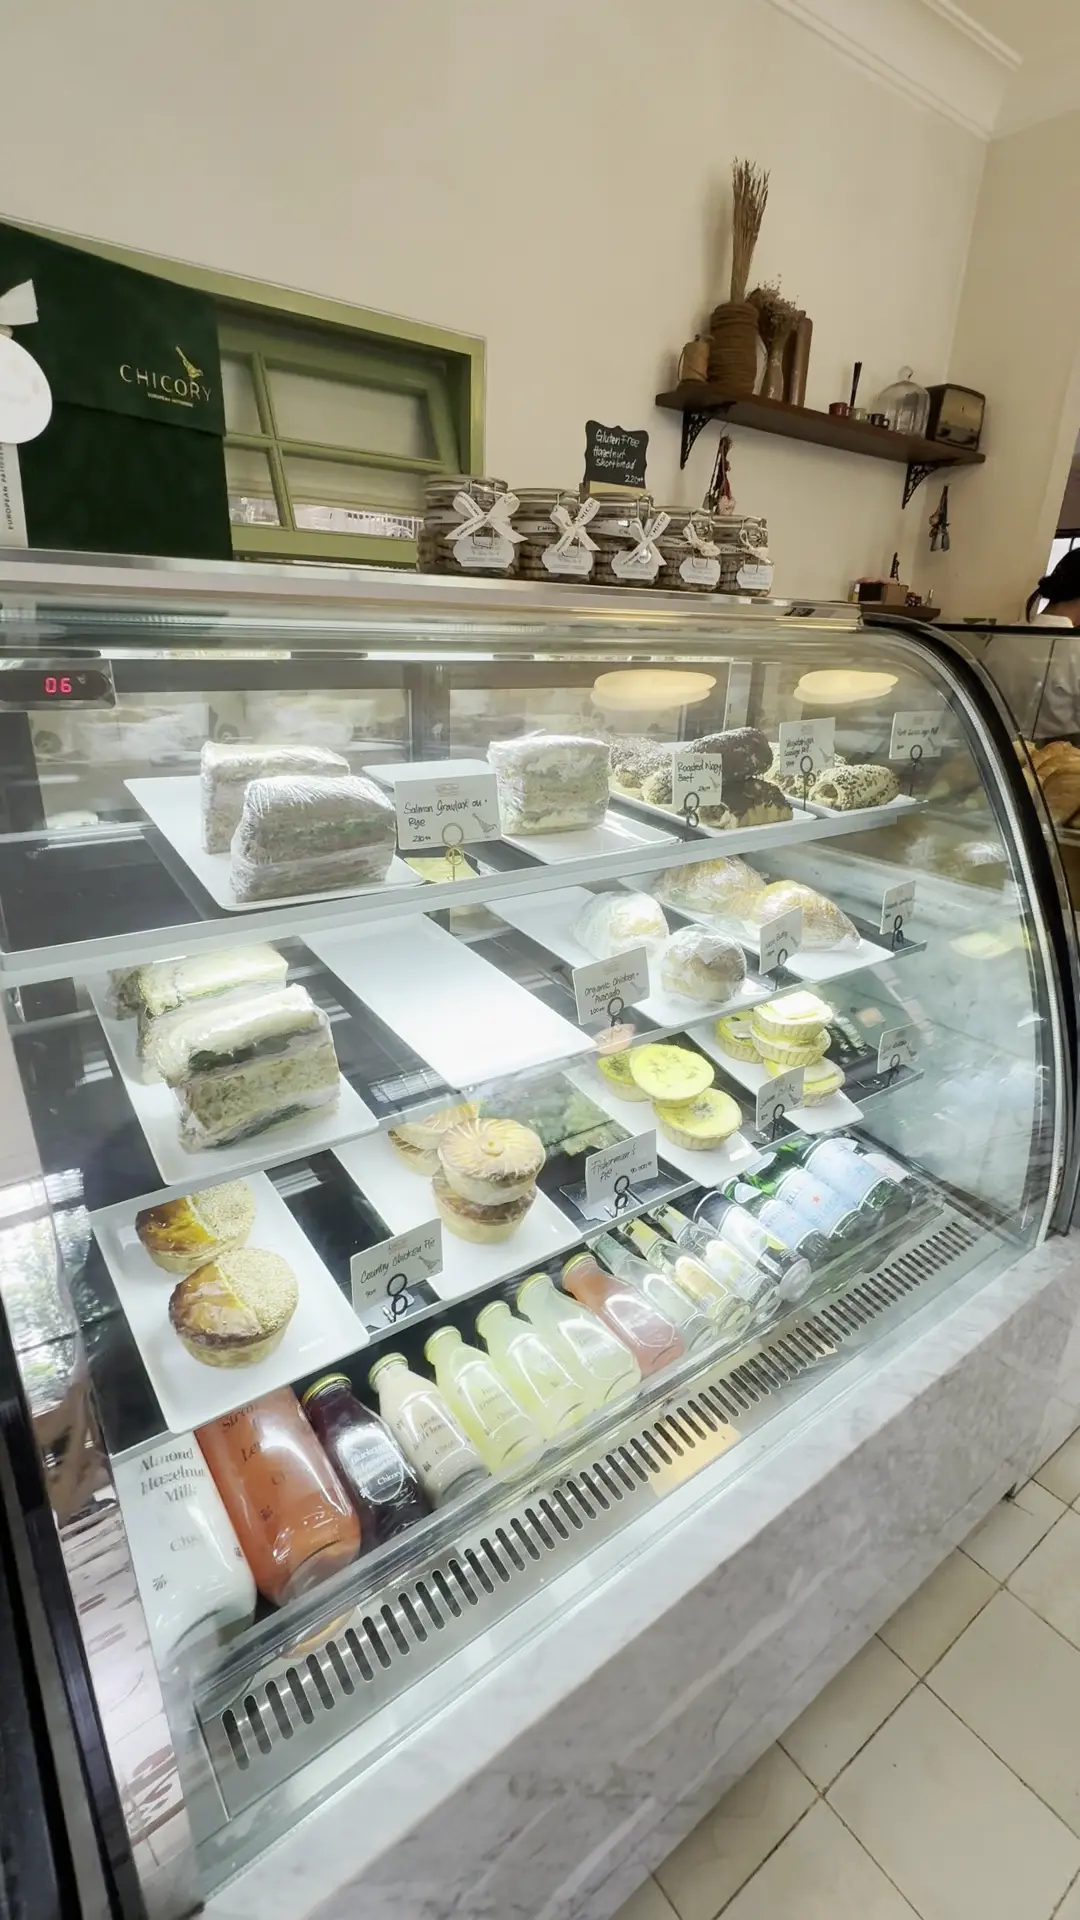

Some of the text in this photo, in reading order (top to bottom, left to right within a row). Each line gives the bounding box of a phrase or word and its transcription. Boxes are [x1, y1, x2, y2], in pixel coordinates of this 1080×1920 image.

[120, 364, 211, 401] CHICORY
[45, 677, 72, 693] 06
[404, 802, 434, 814] Salmon
[408, 817, 426, 829] Rye
[361, 1263, 390, 1284] Country
[392, 1245, 422, 1267] Chicken
[141, 1447, 194, 1472] Almond
